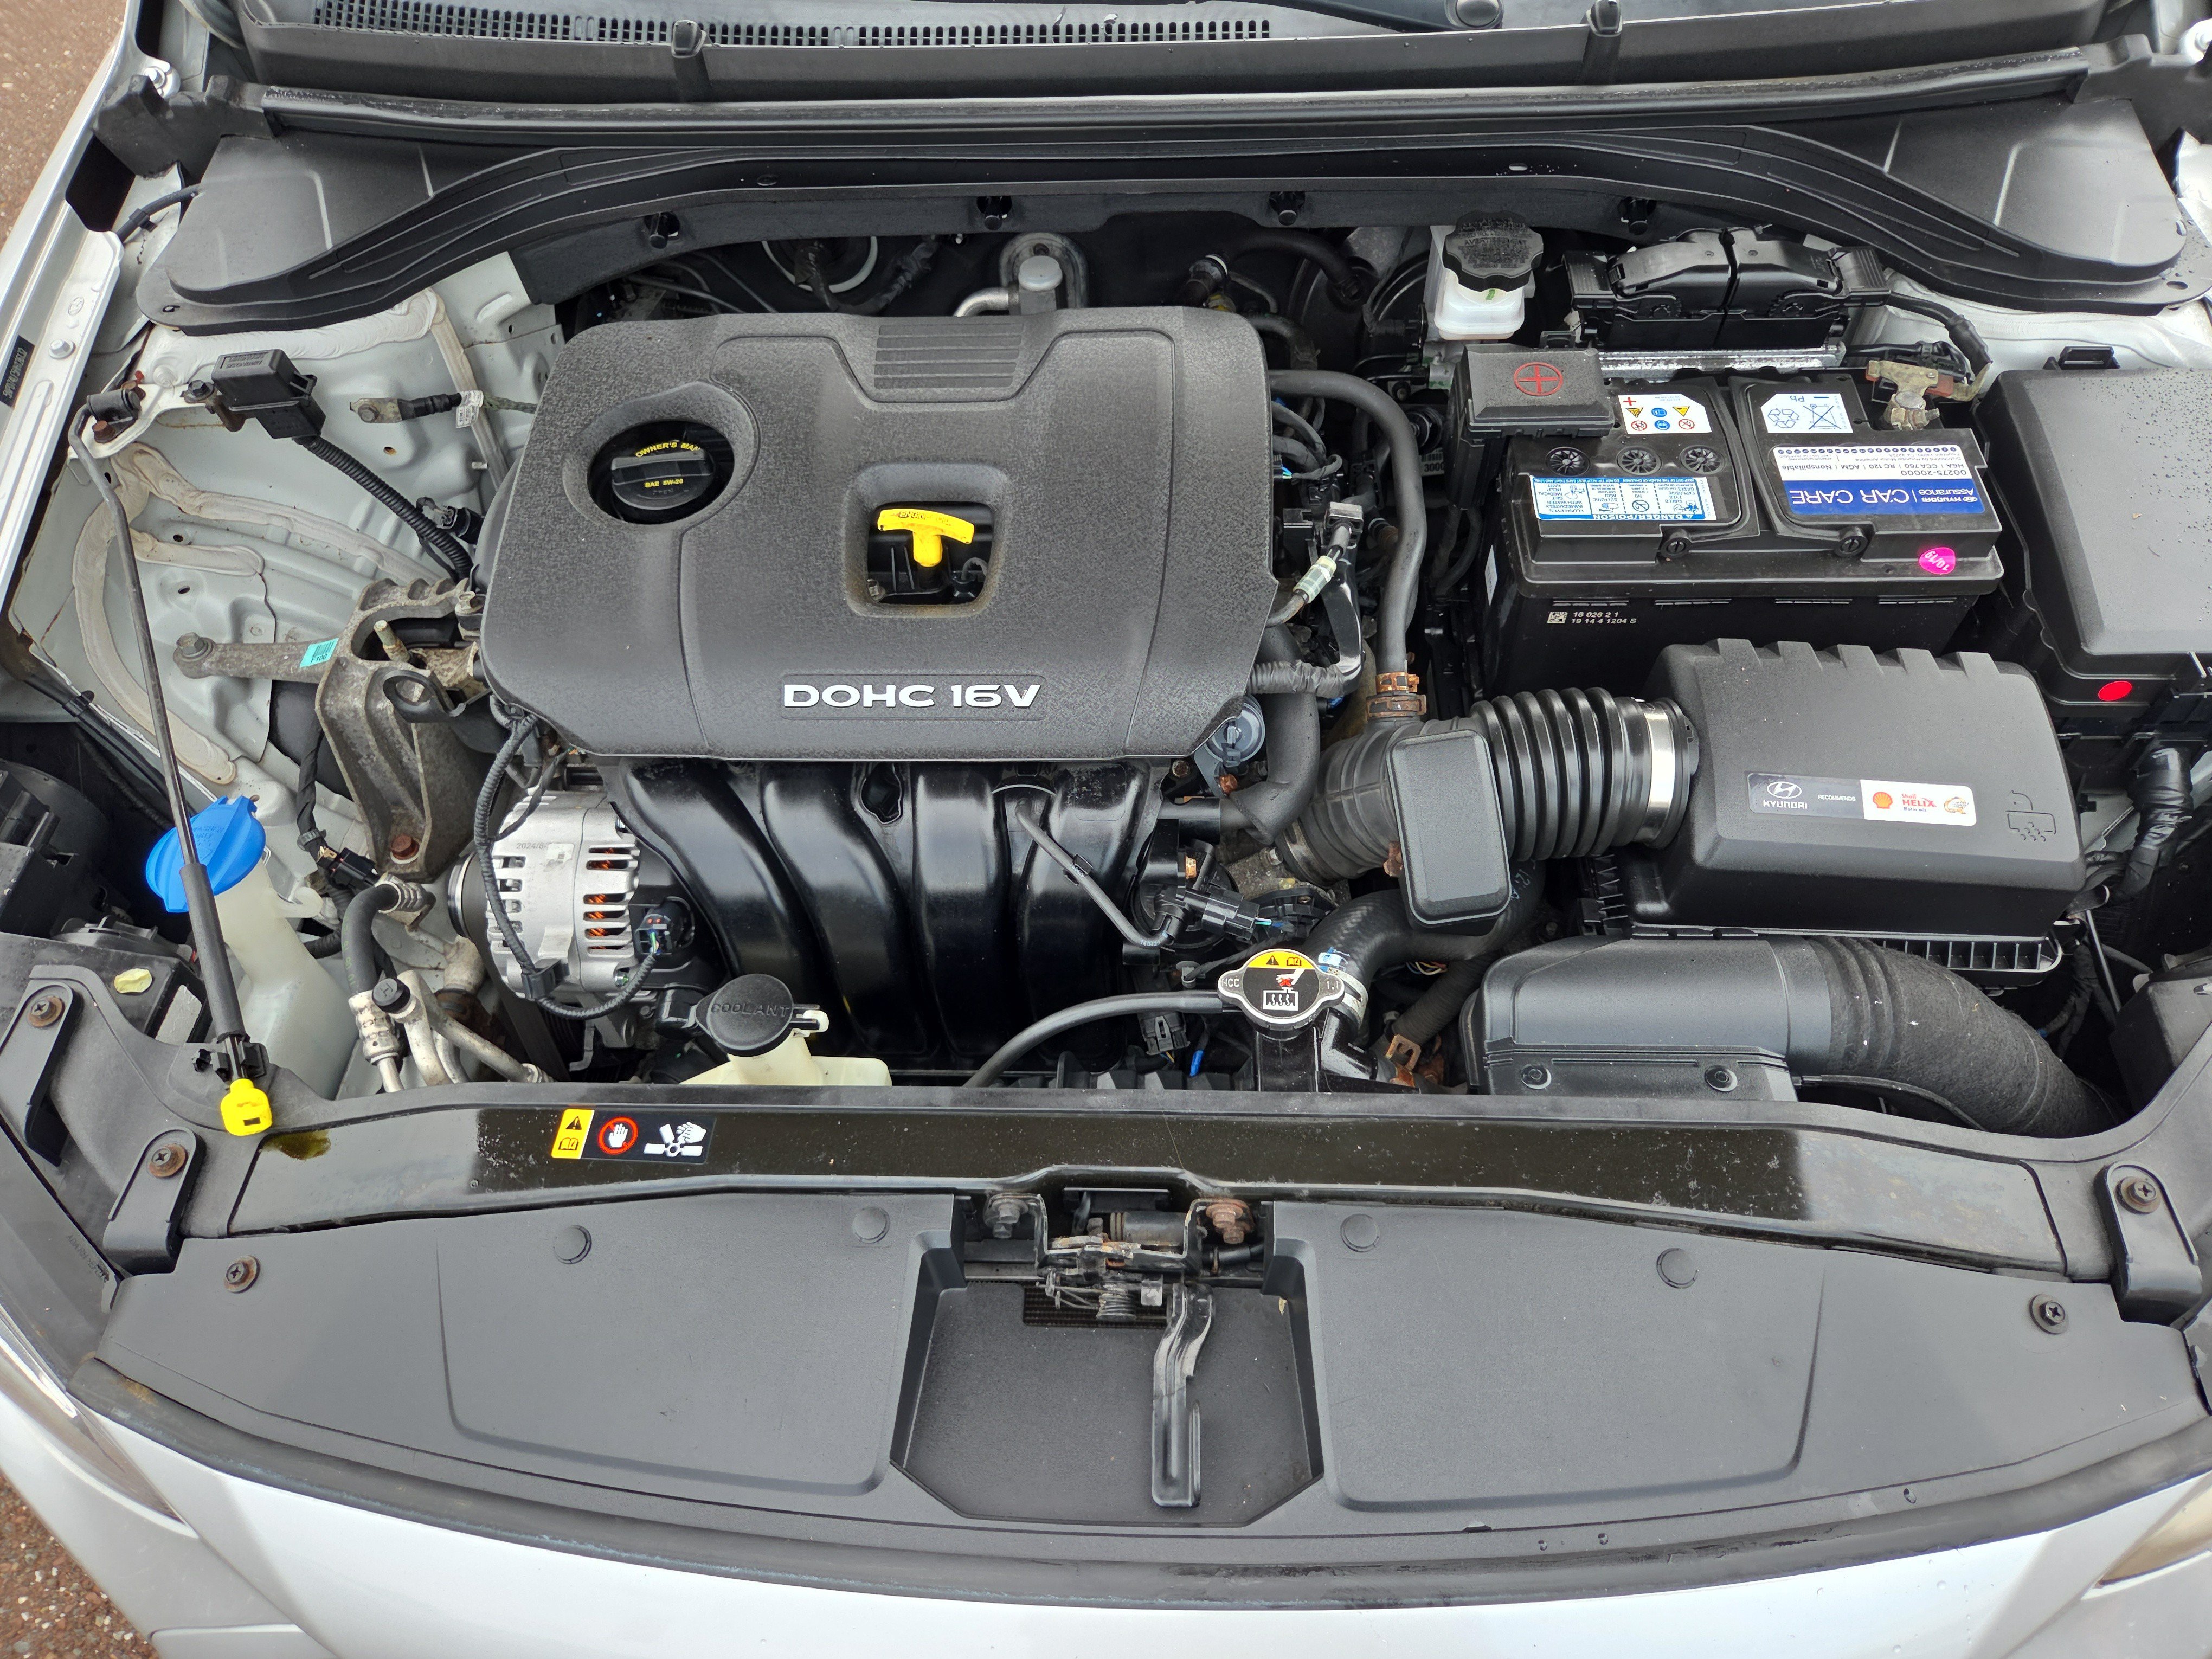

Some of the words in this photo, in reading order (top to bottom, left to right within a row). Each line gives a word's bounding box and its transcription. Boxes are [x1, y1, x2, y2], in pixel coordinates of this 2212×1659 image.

[635, 442, 677, 458] OWNER'S
[1789, 490, 1854, 504] CARE
[1859, 489, 1909, 503] CAR
[1925, 551, 1950, 571] 10/19
[783, 684, 935, 708] DOHC
[951, 684, 1041, 709] 16V
[1763, 800, 1807, 809] HYUNDAI
[1902, 798, 1937, 807] HELIX
[1221, 978, 1240, 988] HCC
[1326, 981, 1340, 990] 1.1
[711, 1002, 790, 1018] COOLANT
